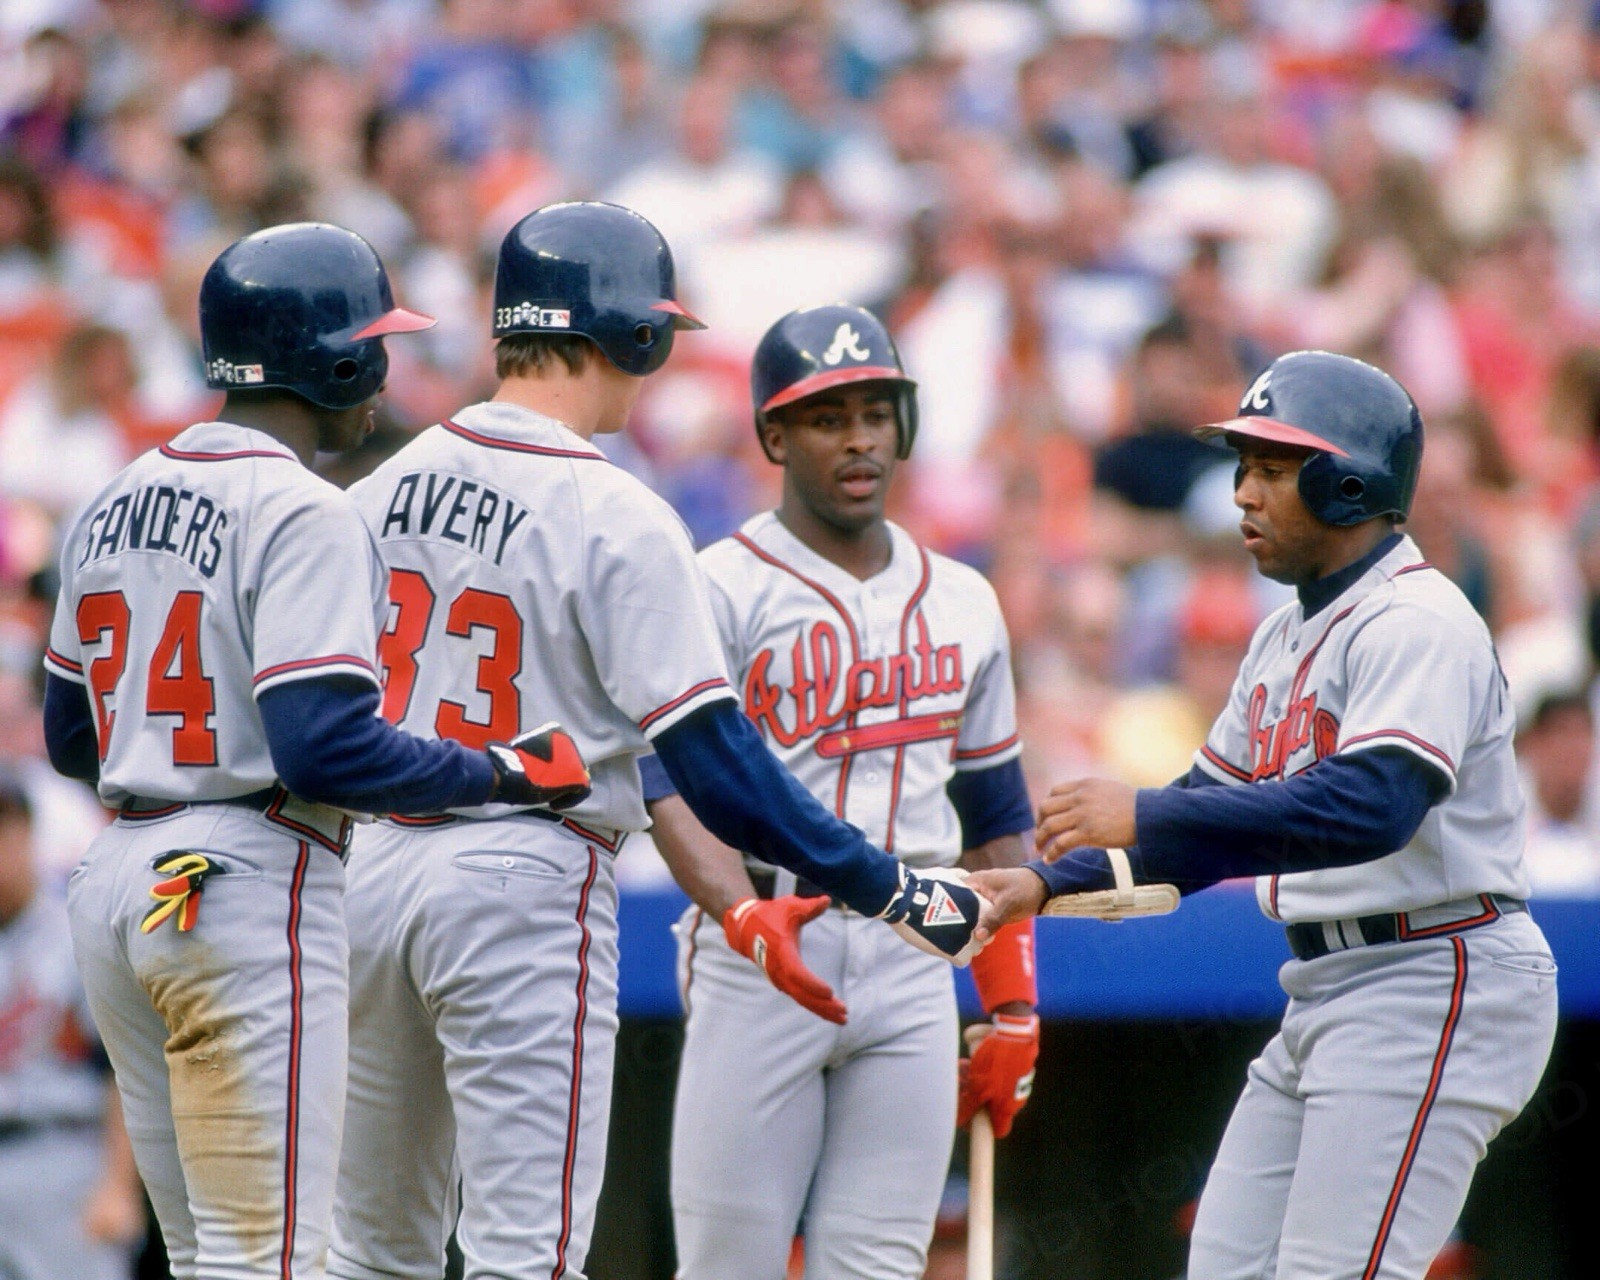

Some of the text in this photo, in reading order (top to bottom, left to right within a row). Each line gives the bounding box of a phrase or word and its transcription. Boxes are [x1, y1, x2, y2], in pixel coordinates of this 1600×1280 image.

[496, 307, 511, 328] 33
[823, 322, 870, 365] A
[78, 486, 228, 579] SANDERS
[382, 472, 528, 566] AVERY
[76, 589, 219, 767] 24
[745, 606, 964, 747] Atlanta
